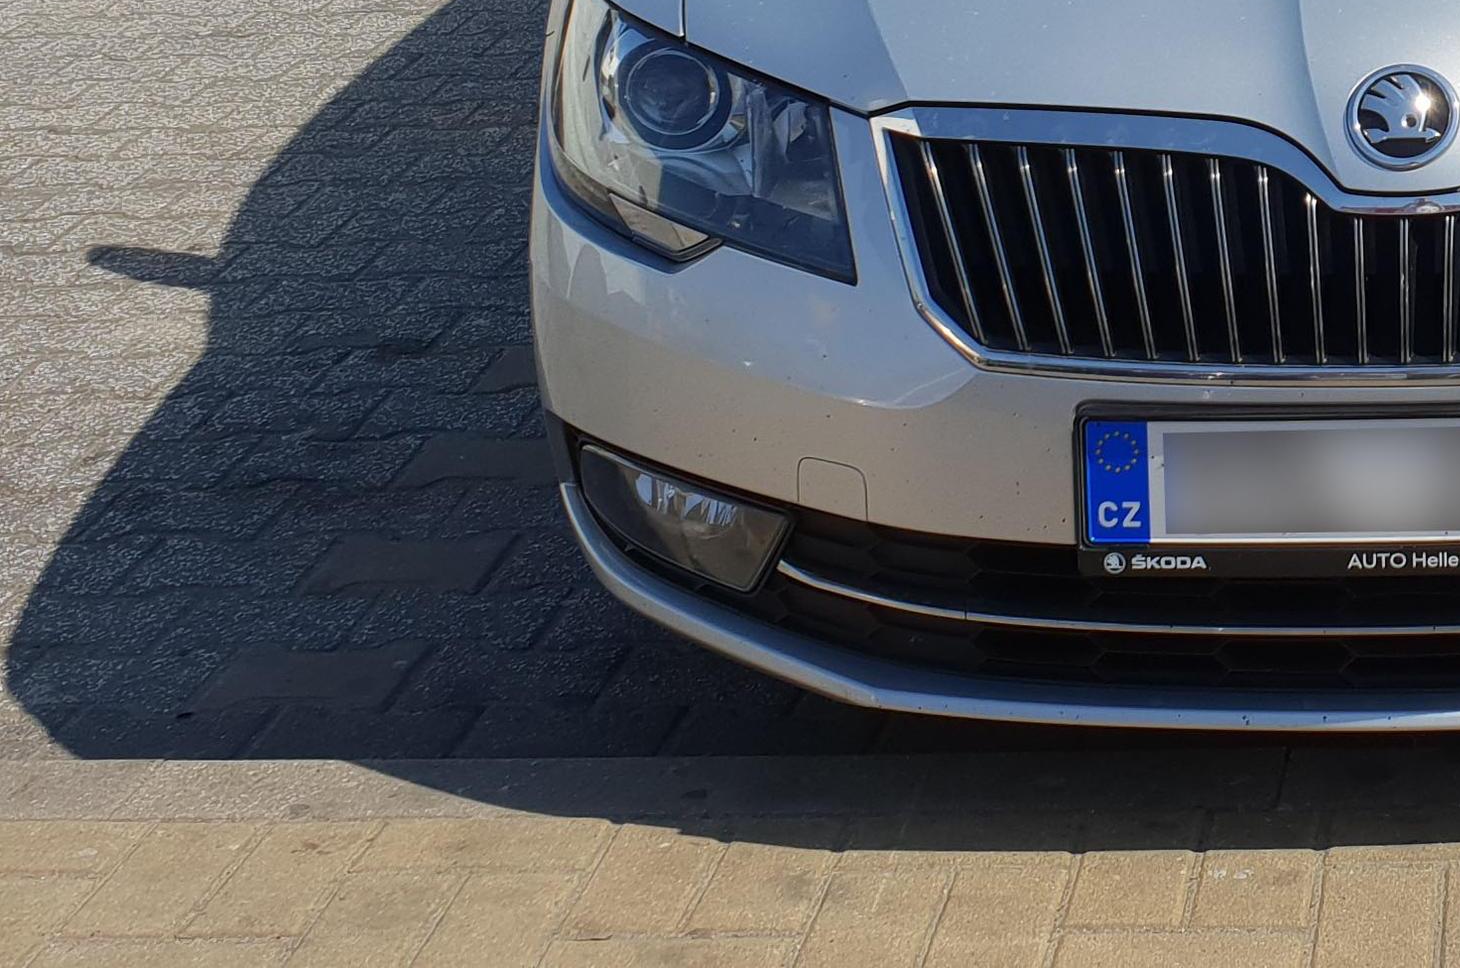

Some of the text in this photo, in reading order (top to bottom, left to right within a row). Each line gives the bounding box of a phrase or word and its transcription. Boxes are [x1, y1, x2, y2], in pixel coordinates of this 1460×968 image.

[1098, 500, 1142, 528] CZ
[1131, 554, 1207, 570] ŠKODA
[1347, 552, 1407, 569] AUTO
